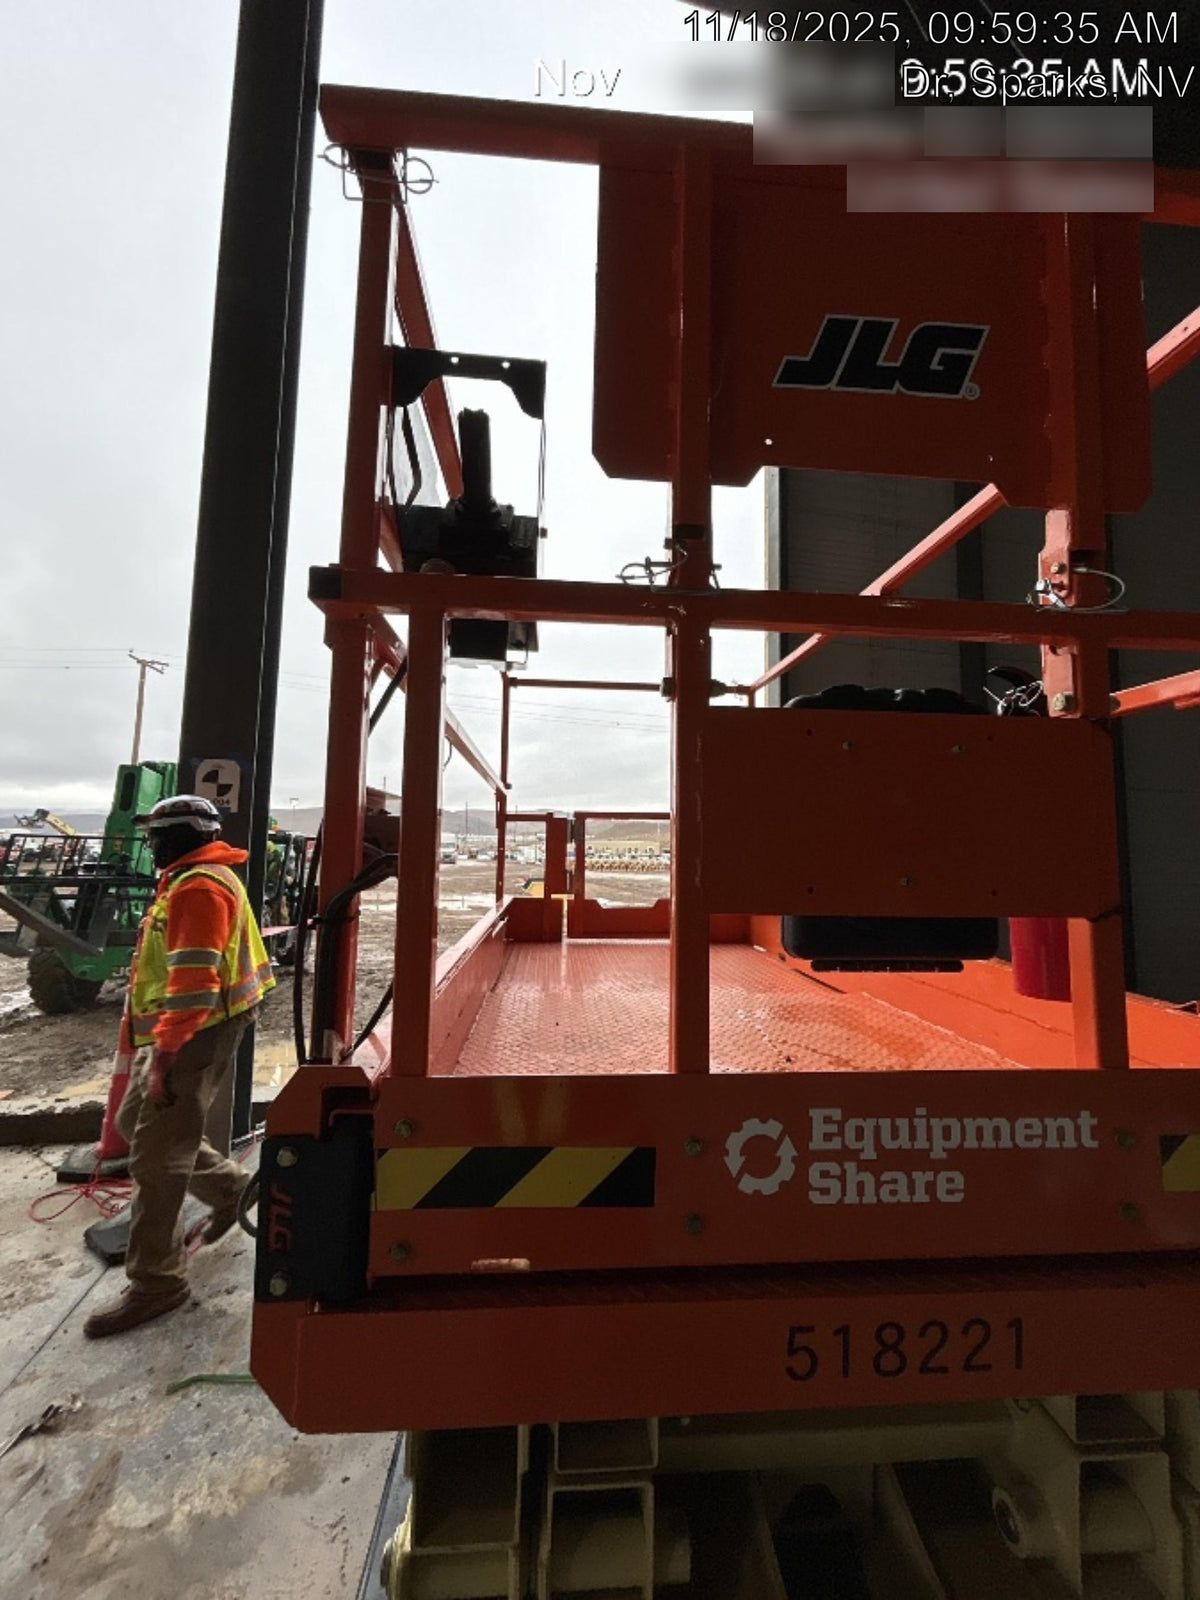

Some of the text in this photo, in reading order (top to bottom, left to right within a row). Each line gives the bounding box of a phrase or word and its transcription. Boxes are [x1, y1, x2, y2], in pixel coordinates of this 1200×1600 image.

[772, 314, 991, 398] JLG
[808, 1107, 1099, 1160] Equipment
[808, 1161, 965, 1204] Share
[268, 1182, 294, 1250] JLG
[785, 1317, 1024, 1382] 518221
